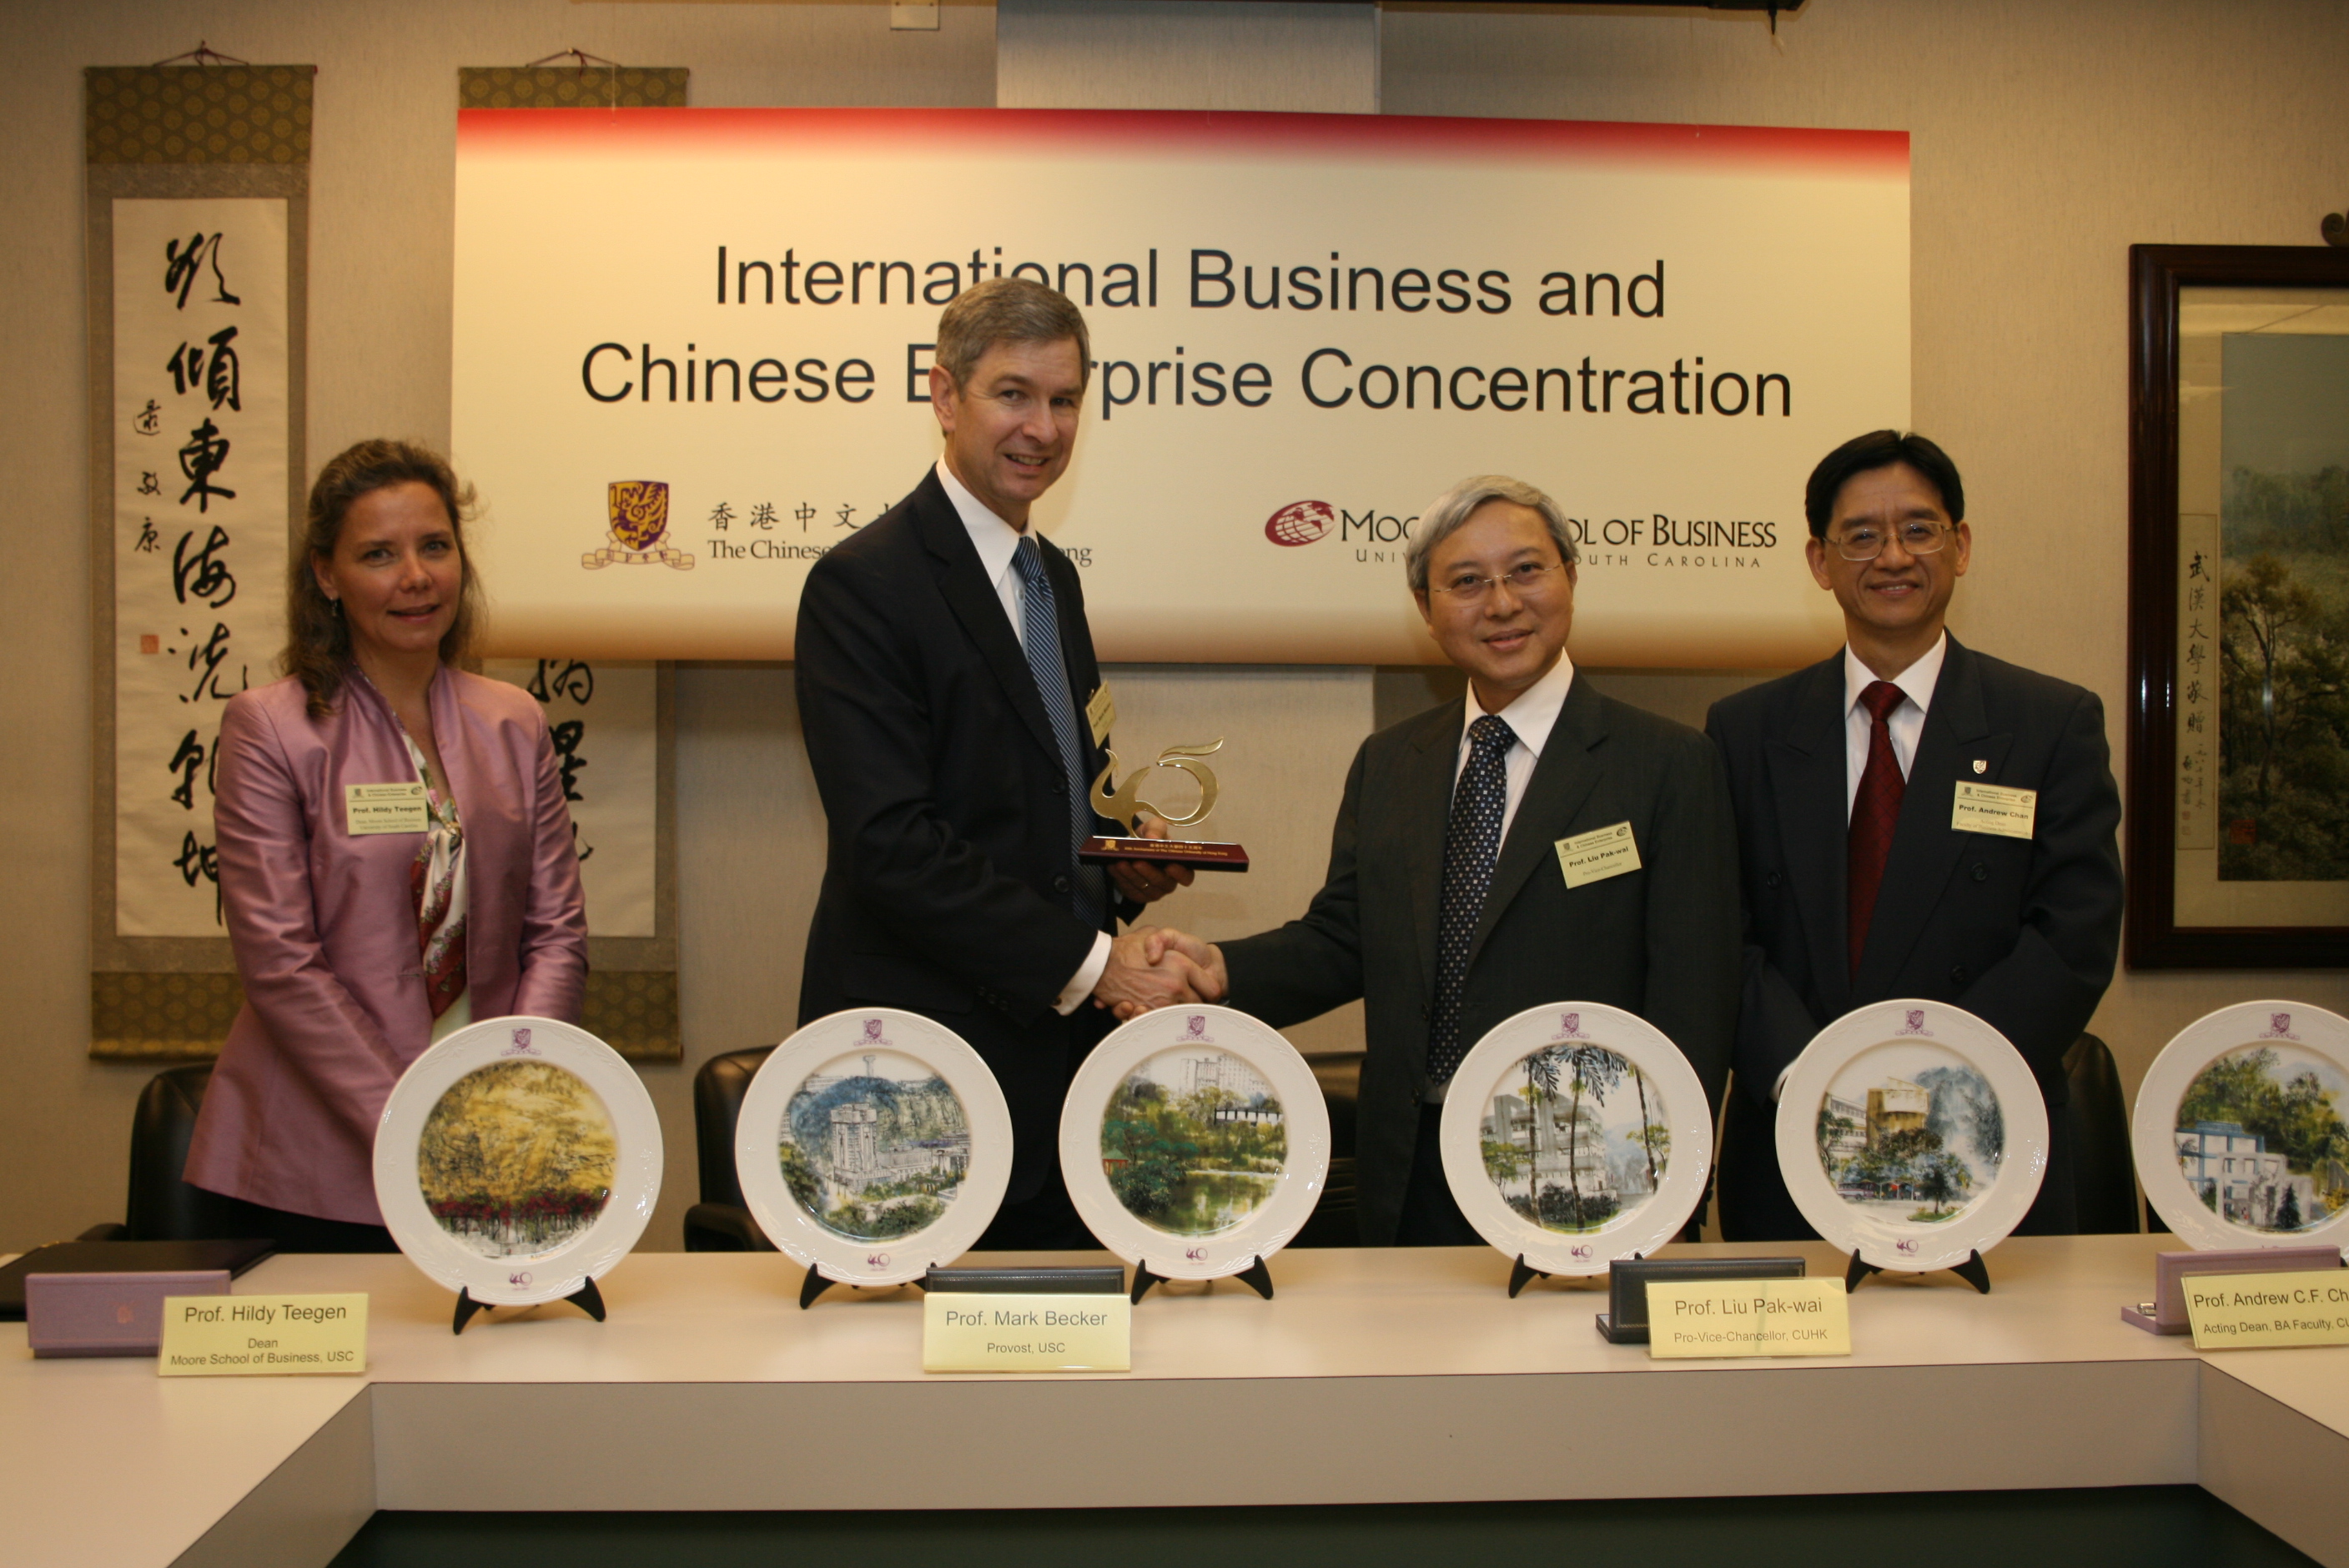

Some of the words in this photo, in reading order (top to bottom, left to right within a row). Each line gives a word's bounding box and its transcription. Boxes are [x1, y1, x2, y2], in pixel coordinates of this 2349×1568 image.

[1189, 248, 1512, 314] Business
[1538, 259, 1665, 319] and
[582, 342, 875, 404] Chinese
[907, 343, 1273, 421] Eprise
[1300, 347, 1792, 417] Concentration
[708, 501, 890, 534] 香港中文
[1602, 519, 1644, 545] OF
[1652, 514, 1778, 548] BUSINESS
[707, 540, 747, 560] The
[750, 539, 830, 560] Chinese
[1059, 546, 1093, 568] ng
[1573, 554, 1628, 566] OUTH
[1647, 552, 1761, 568] CAROLINA
[1959, 804, 1976, 812] Prof.
[1979, 807, 2008, 817] Andrew
[2009, 812, 2029, 820] Chan
[1569, 859, 1587, 868] Prof.
[1587, 855, 1599, 863] Liu
[1600, 846, 1629, 859] Pak-wai
[1674, 1299, 1716, 1315] Prof.
[1722, 1299, 1748, 1314] Liu
[1753, 1297, 1823, 1314] Pak-wai
[2193, 1293, 2230, 1308] Prof.
[2233, 1291, 2289, 1306] Andrew
[2294, 1289, 2324, 1304] C.F.
[184, 1305, 224, 1324] Prof.
[231, 1304, 276, 1324] Hildy
[282, 1304, 347, 1324] Teegen
[946, 1310, 988, 1326] Prof.
[994, 1310, 1039, 1326] Mark
[1044, 1310, 1108, 1326] Becker
[1674, 1329, 1789, 1343] Pro-Vice-Chancellor,
[1792, 1329, 1828, 1340] CUHK
[2203, 1323, 2237, 1335] Acting
[2239, 1321, 2272, 1333] Dean,
[2274, 1319, 2291, 1331] BA
[2292, 1319, 2334, 1332] Faculty,
[247, 1338, 279, 1349] Dean
[987, 1342, 1035, 1354] Provost,
[1038, 1342, 1066, 1354] USC
[170, 1355, 207, 1365] Moore
[209, 1353, 249, 1364] School
[253, 1353, 265, 1364] of
[267, 1351, 323, 1364] Business,
[327, 1350, 355, 1362] USC
